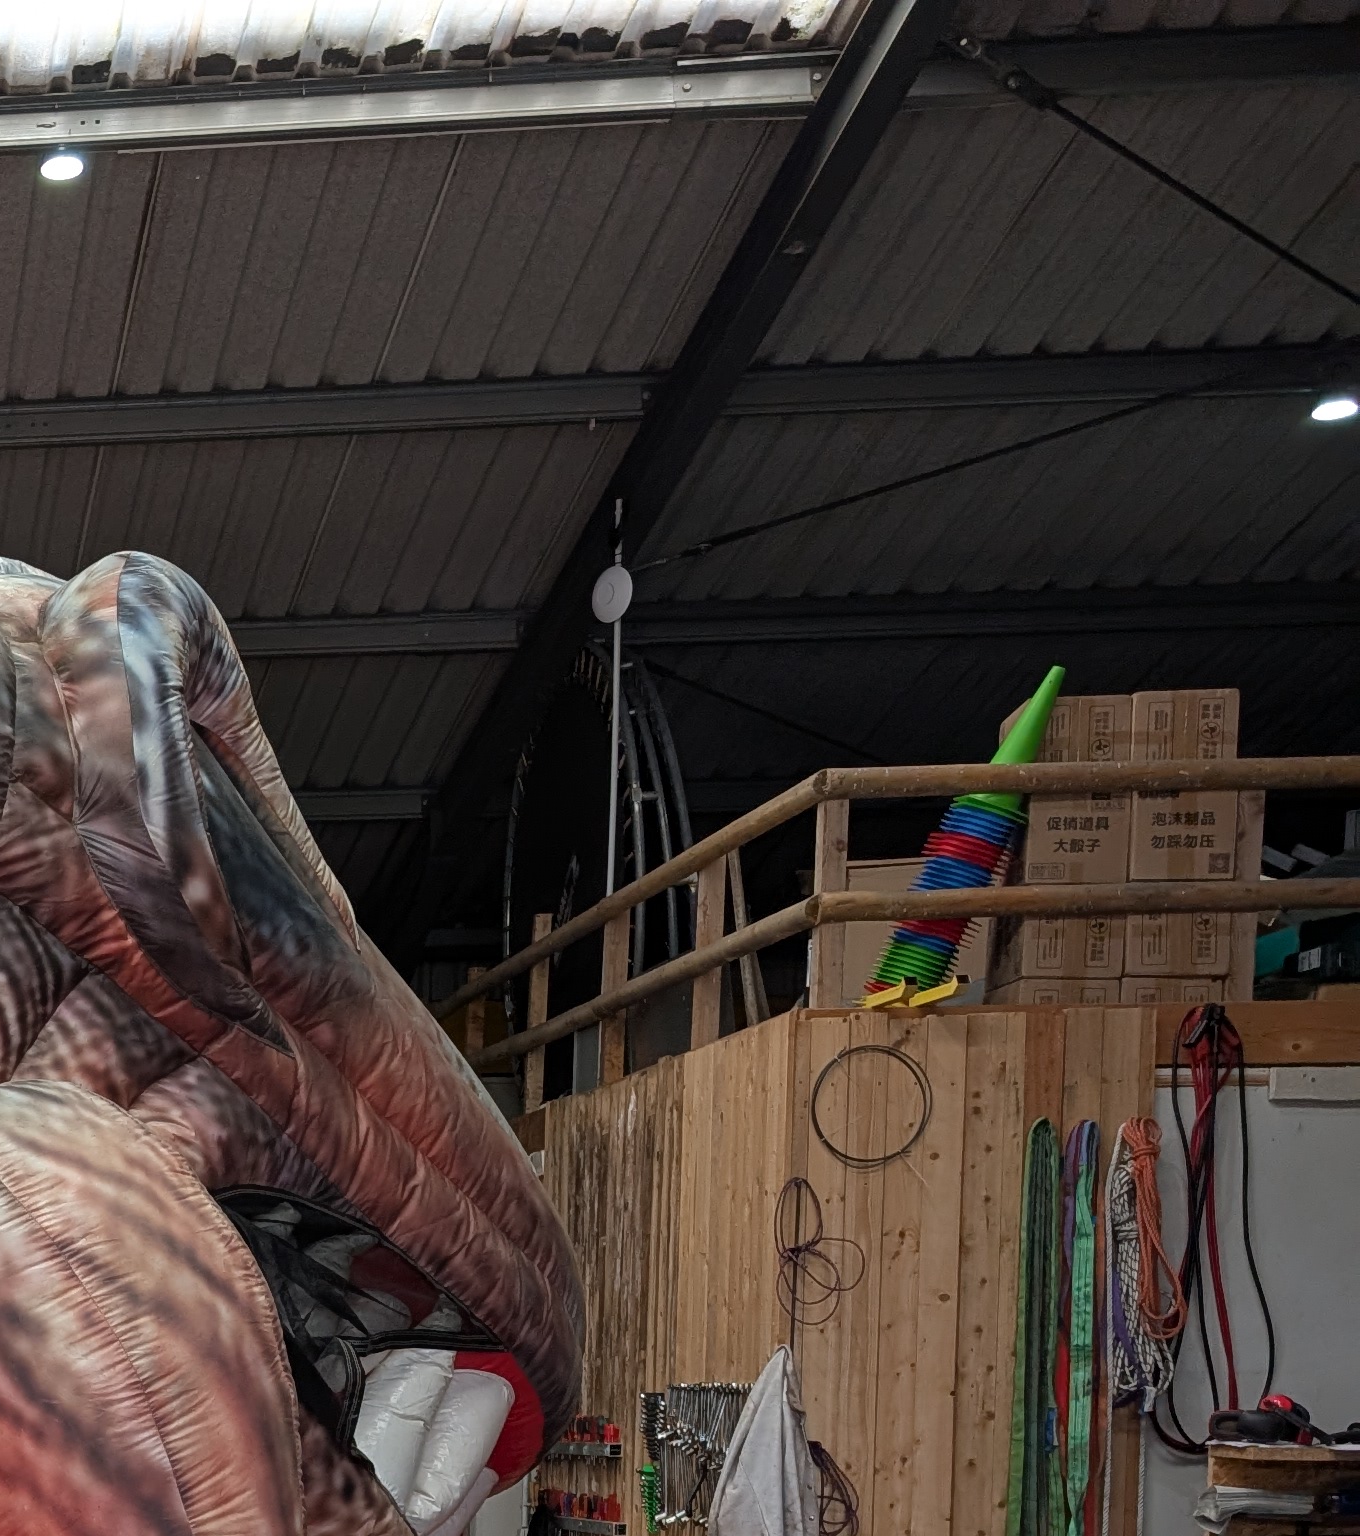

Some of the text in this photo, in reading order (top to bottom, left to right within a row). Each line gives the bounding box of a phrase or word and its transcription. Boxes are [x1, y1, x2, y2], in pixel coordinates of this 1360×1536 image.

[1046, 816, 1110, 832] 促销道具
[1151, 811, 1216, 827] 泡沫制品
[1053, 838, 1101, 854] 大骰子
[1151, 834, 1216, 850] 勿踩勿压
